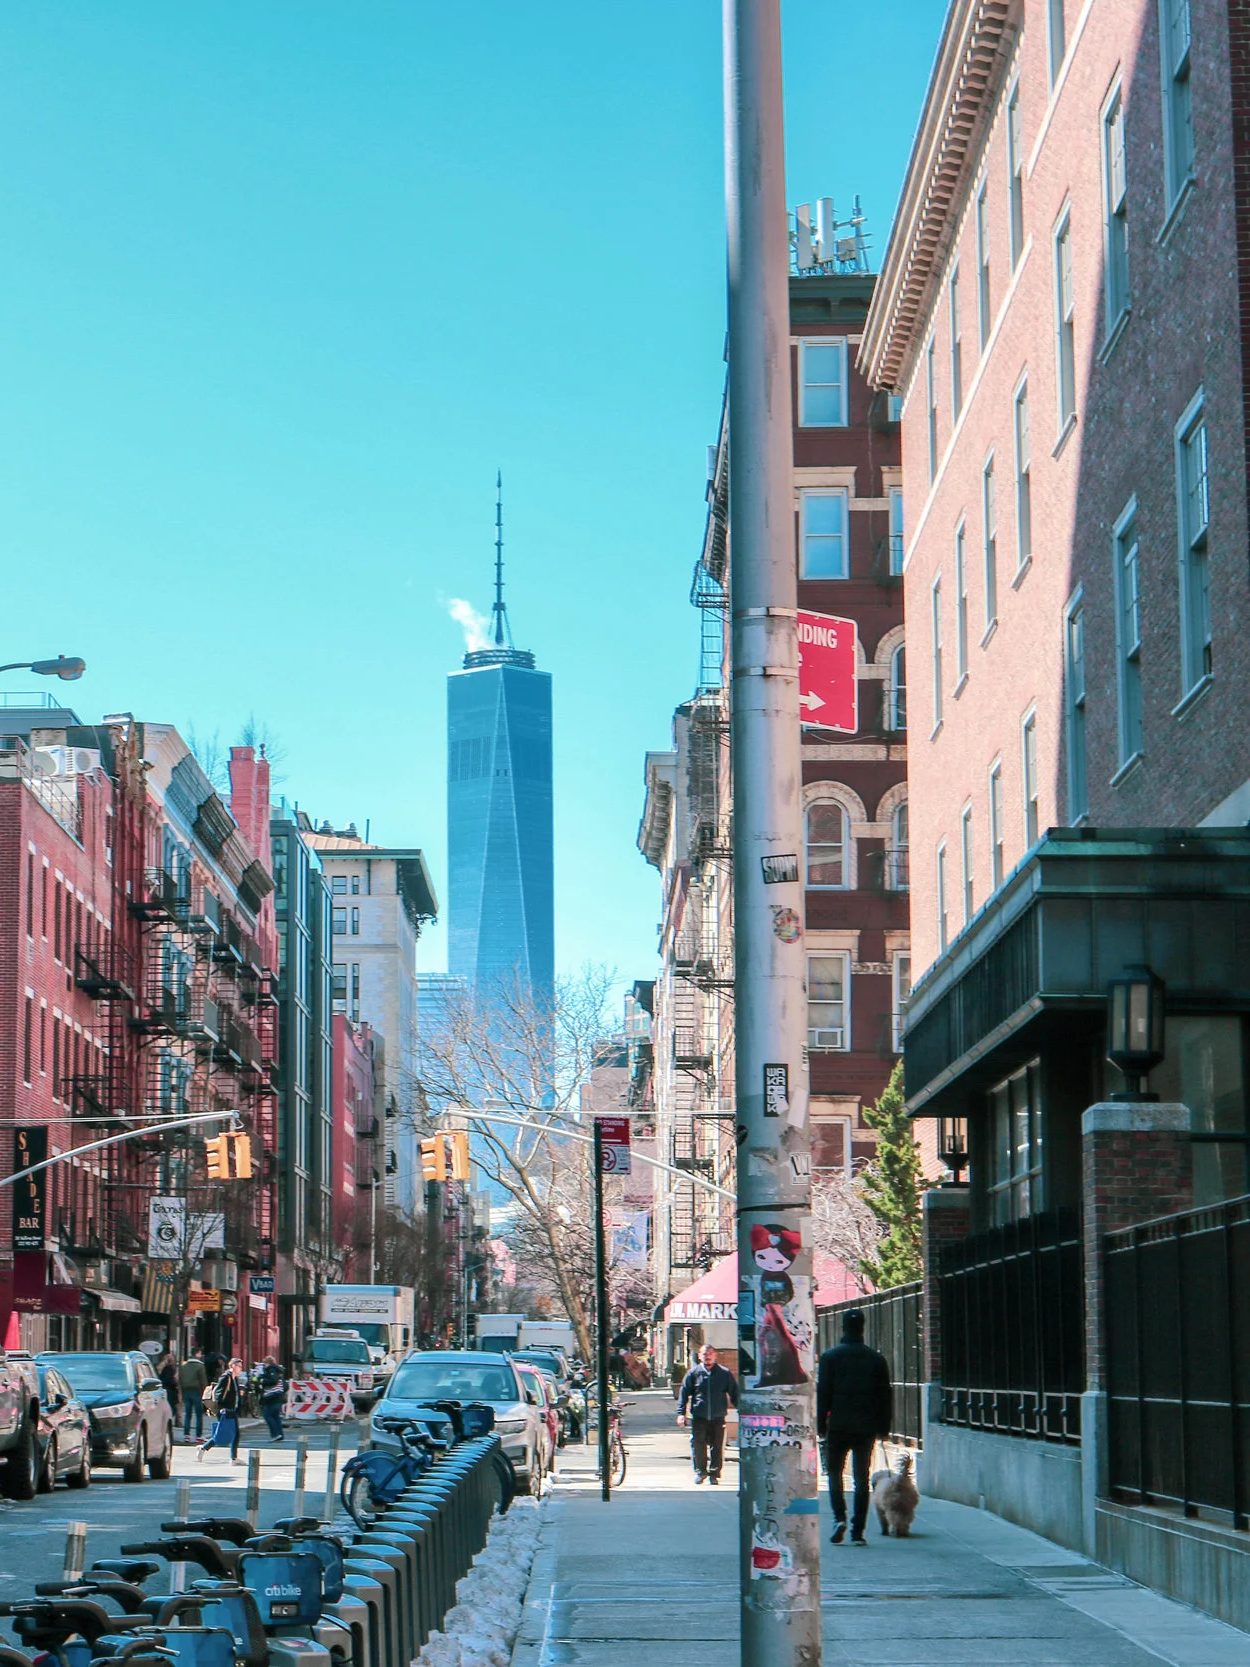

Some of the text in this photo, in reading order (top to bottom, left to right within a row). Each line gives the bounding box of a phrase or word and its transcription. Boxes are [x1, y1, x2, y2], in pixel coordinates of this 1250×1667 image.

[797, 623, 838, 649] NDING
[19, 1217, 40, 1229] BAR
[686, 1302, 738, 1319] MARK
[281, 1584, 302, 1596] bike
